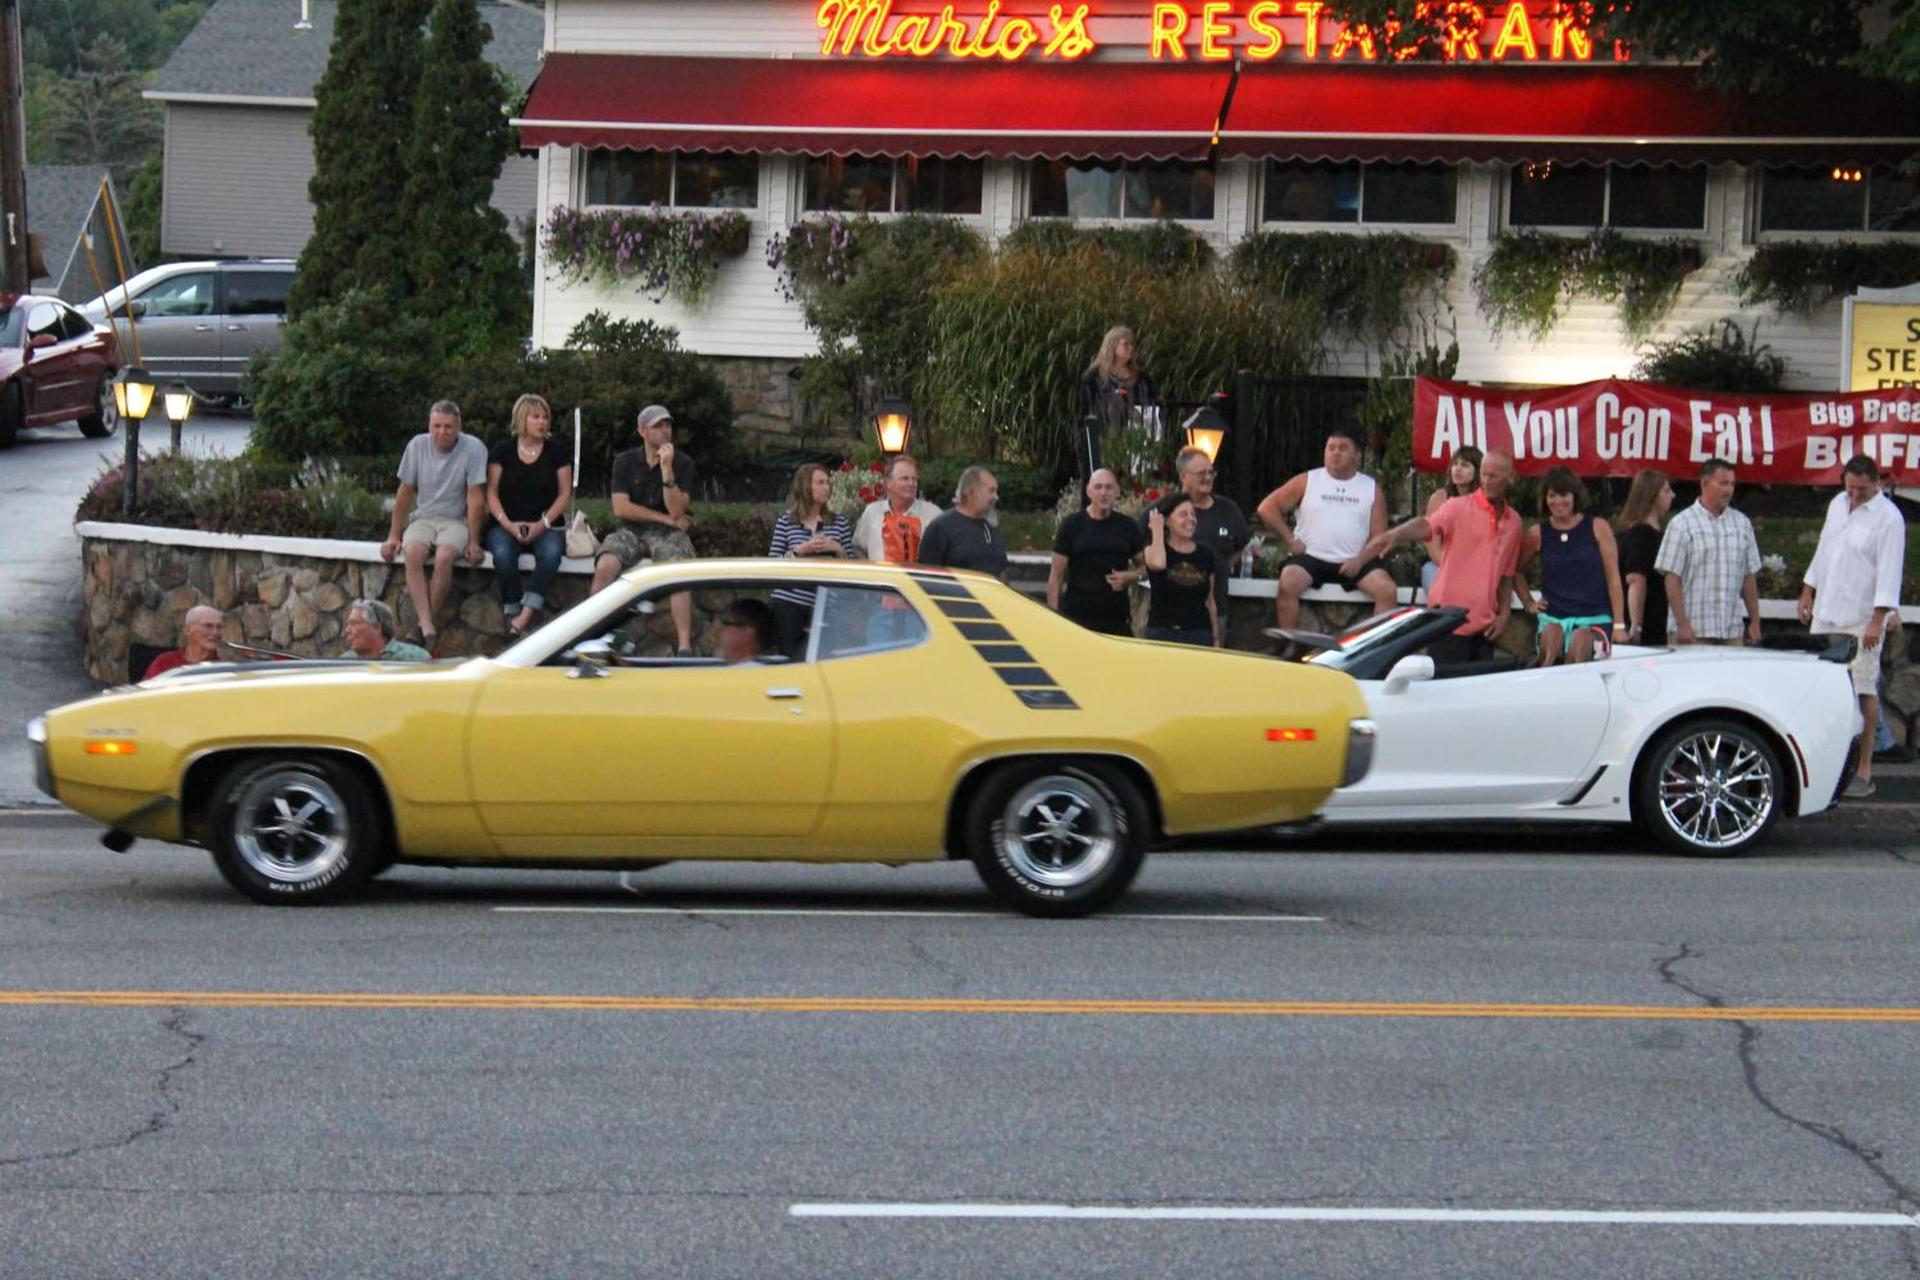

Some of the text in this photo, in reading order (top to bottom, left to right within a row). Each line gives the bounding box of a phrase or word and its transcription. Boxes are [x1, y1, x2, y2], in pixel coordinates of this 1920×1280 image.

[817, 0, 1632, 61] Mario's RESTARAN
[1867, 347, 1920, 372] STE
[1431, 392, 1774, 466] All You Can Eat!
[1809, 401, 1855, 428] Big
